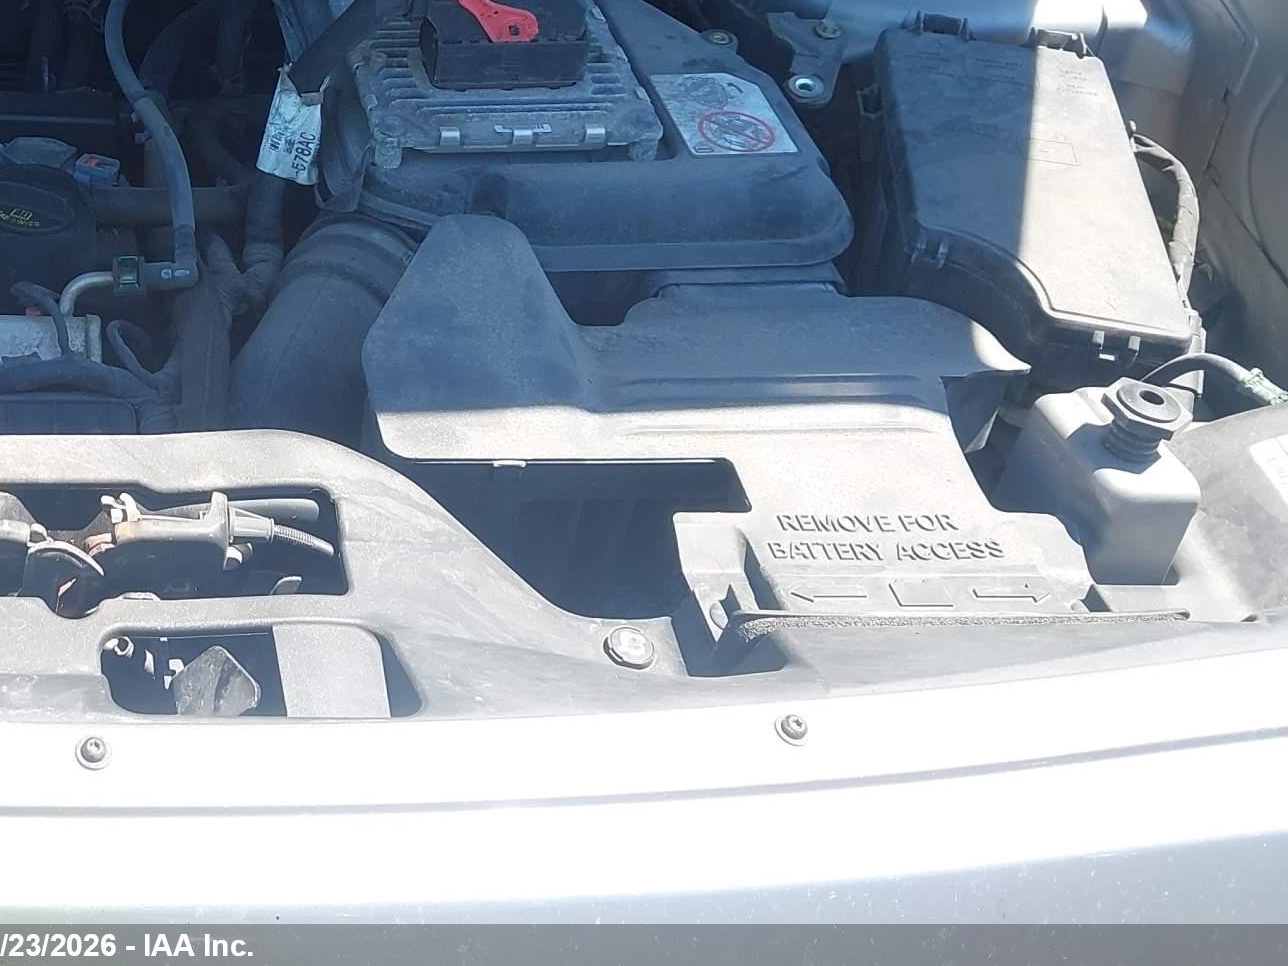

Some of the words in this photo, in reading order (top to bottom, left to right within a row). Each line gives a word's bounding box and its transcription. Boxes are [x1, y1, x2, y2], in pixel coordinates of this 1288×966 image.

[776, 513, 896, 533] REMOVE
[897, 513, 960, 532] FOR
[768, 541, 885, 562] BATTERY
[896, 539, 1006, 562] ACCESS
